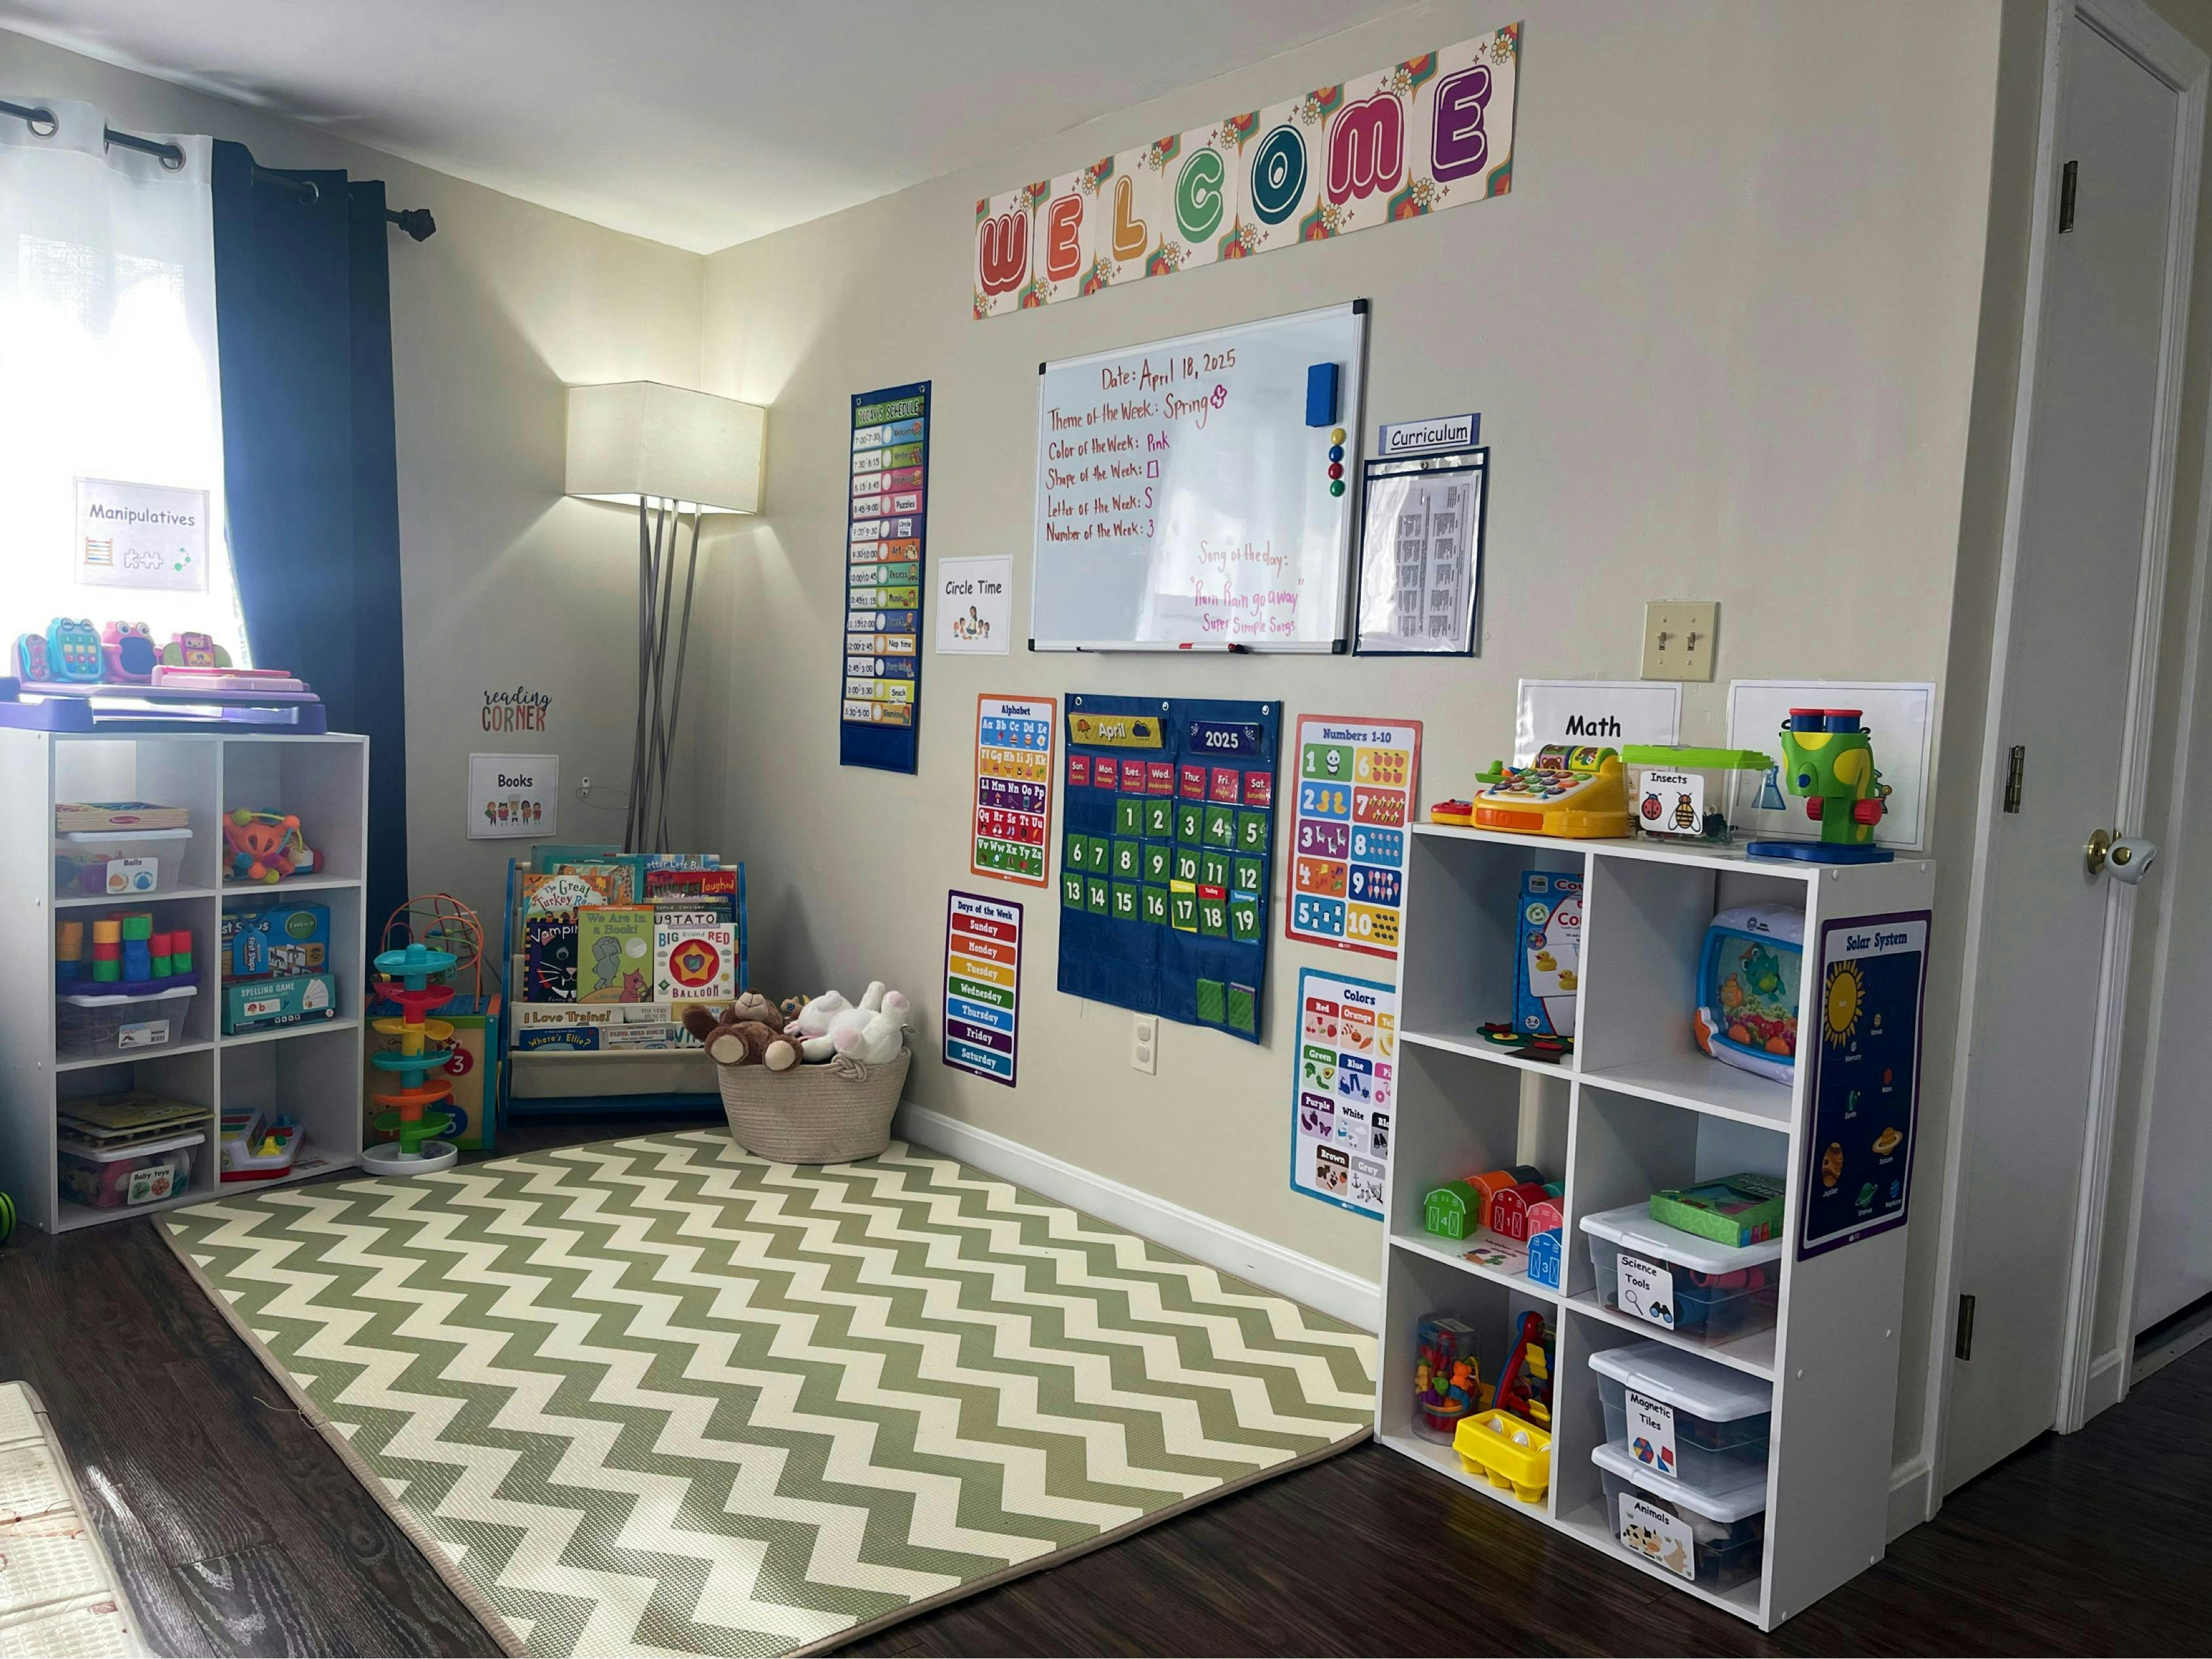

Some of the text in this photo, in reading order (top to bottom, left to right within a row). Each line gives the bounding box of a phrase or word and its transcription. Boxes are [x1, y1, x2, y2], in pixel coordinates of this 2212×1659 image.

[979, 63, 1493, 295] WELCOME
[1102, 349, 1236, 391] Date: April 18, 2025
[886, 401, 918, 419] SCHEDULE
[1047, 393, 1209, 431] Theme of the Week: Spring
[1392, 424, 1467, 446] Curriculum
[1049, 431, 1169, 460] Color of the Week: Pink
[1045, 461, 1142, 490] Shape of the Week:
[1048, 488, 1153, 517] Letter of the Week: S
[90, 504, 195, 526] Manipulatives
[1047, 520, 1154, 541] Number of the Week: 3
[892, 546, 901, 554] Art
[1199, 541, 1225, 571] Song
[1231, 546, 1241, 562] of
[946, 580, 1002, 594] Circle Time
[1224, 582, 1248, 608] Rain
[1251, 595, 1266, 615] go
[1203, 613, 1295, 637] Super Simple Songs
[484, 686, 552, 712] reading
[482, 705, 546, 732] CORNER
[1002, 705, 1030, 715] Alphabet
[1566, 715, 1620, 738] Math
[1099, 723, 1239, 748] April 2025
[1323, 728, 1392, 743] Numbers 1-10
[498, 774, 532, 787] Books
[1072, 761, 1084, 771] Sun.
[1098, 764, 1114, 774] Mon.
[1125, 767, 1140, 777] Tues.
[1152, 770, 1170, 779] Wed.
[1218, 775, 1229, 785] Fri.
[1251, 779, 1265, 789] Sat.
[1651, 772, 1687, 785] Insects
[1127, 808, 1257, 843] 1 2 3 4 5
[1074, 843, 1256, 888] 6 7 8 9 10 11 12
[544, 880, 590, 898] The Great
[702, 877, 734, 893] laughed
[538, 893, 571, 911] Turkey
[958, 901, 973, 913] Days
[984, 907, 994, 916] the
[996, 909, 1012, 920] Week
[1067, 882, 1253, 931] 13 14 15 16 17 18 19
[587, 914, 646, 922] We Are in
[604, 925, 638, 934] Book!
[970, 920, 998, 936] Sunday
[659, 932, 679, 947] BIG
[708, 932, 730, 944] RED
[1846, 931, 1908, 952] Solar System
[969, 942, 998, 958] Monday
[966, 963, 998, 980] Tuesday
[242, 986, 273, 997] SPELLING
[276, 983, 295, 991] GAME
[672, 984, 719, 998] BALLOON
[960, 984, 1002, 1004] Wednesday
[1344, 990, 1375, 1005] Colors
[962, 1005, 999, 1025] Thursday
[1316, 1003, 1329, 1013] Red
[1343, 1008, 1371, 1023] Orange
[524, 1010, 611, 1024] I Love Trains!
[528, 1034, 590, 1047] Where's Ellie?
[967, 1027, 992, 1044] Friday
[453, 1055, 464, 1073] 3
[962, 1048, 996, 1069] Saturday
[1309, 1050, 1332, 1061] Green
[1347, 1059, 1364, 1071] Blue
[1305, 1097, 1330, 1111] Purple
[1342, 1107, 1364, 1120] White
[1321, 1149, 1345, 1164] Brown
[154, 1169, 169, 1178] toys
[1358, 1160, 1378, 1175] Gray
[1507, 1217, 1510, 1226] 1
[1542, 1262, 1548, 1272] 3
[1622, 1257, 1657, 1276] Science
[1625, 1274, 1650, 1291] Tools
[1631, 1393, 1671, 1419] Magnetic
[1639, 1414, 1661, 1431] Tiles
[1634, 1502, 1669, 1525] Animals
